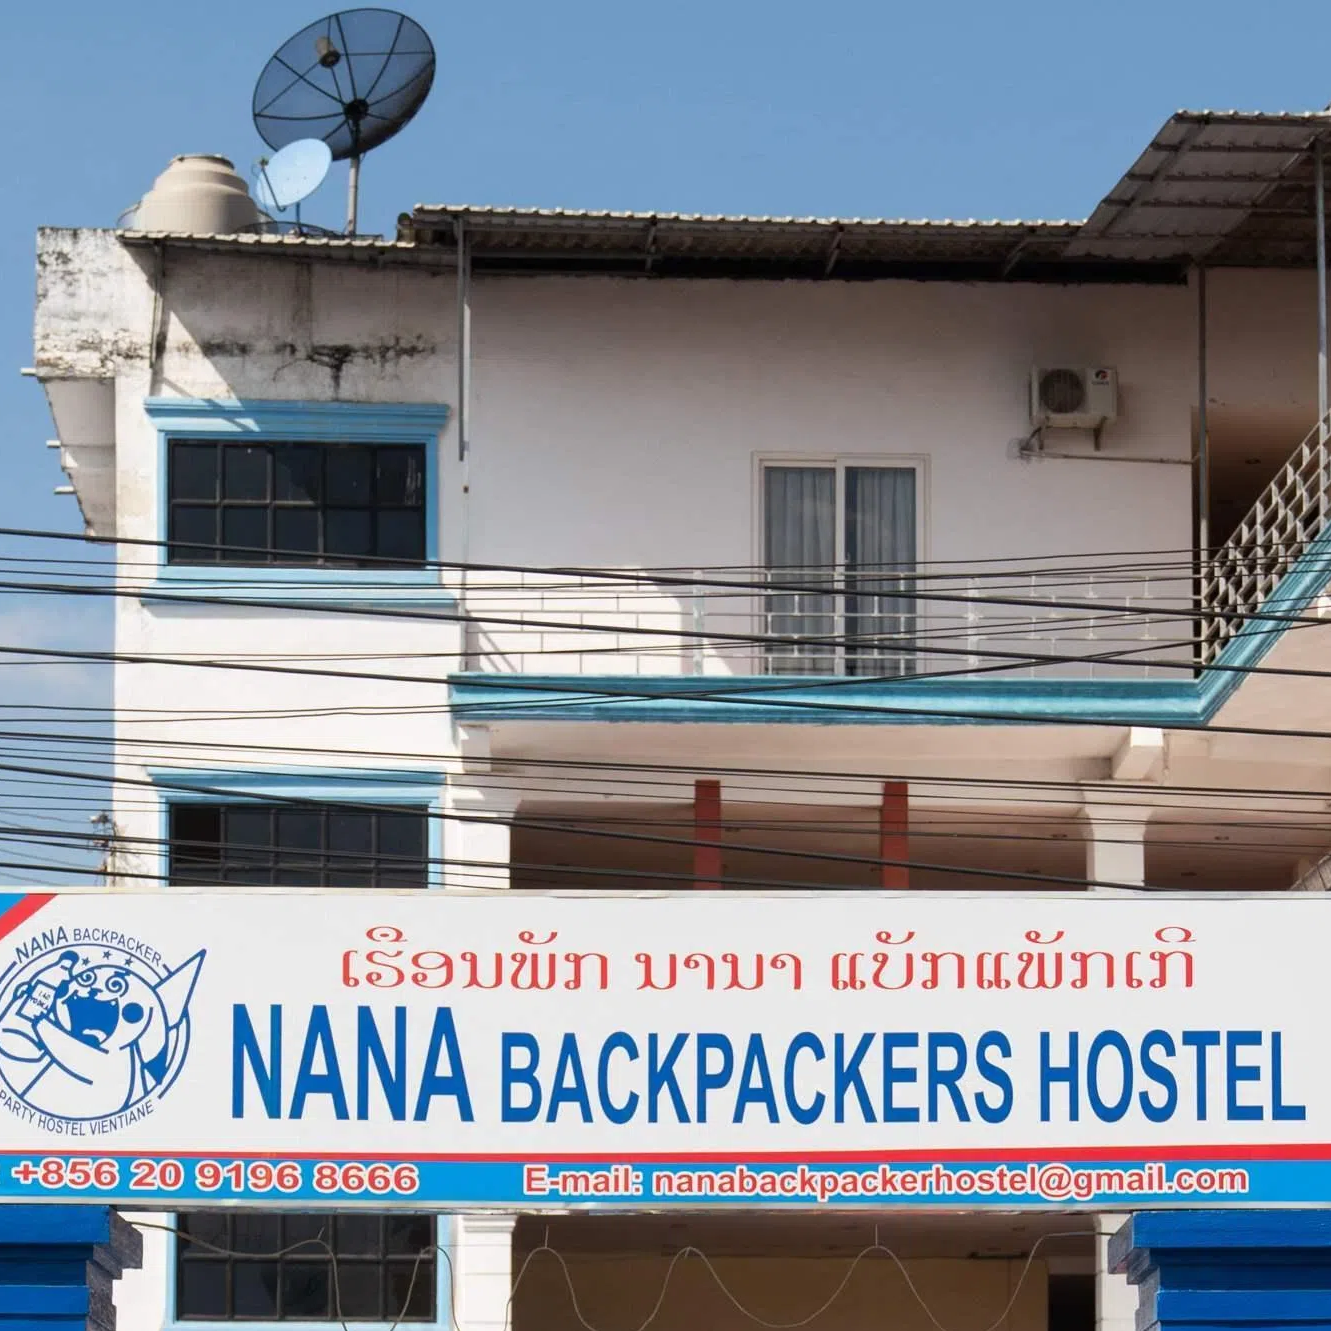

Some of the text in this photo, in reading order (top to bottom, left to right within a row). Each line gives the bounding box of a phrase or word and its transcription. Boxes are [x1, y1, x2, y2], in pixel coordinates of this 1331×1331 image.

[15, 925, 163, 967] NANA BACKPACKER
[634, 952, 802, 990] ນານາ
[231, 1002, 1307, 1126] NANA BACKPACKERS HOSTEL
[37, 1116, 87, 1137] HOSTEL
[89, 1098, 155, 1136] VIENTIANE
[11, 1160, 118, 1189] +856
[131, 1160, 184, 1189] 20
[195, 1161, 301, 1191] 9196
[314, 1164, 419, 1193] 8666
[523, 1163, 1248, 1201] E-mail: nanabackpackerhostel@gmail.com
